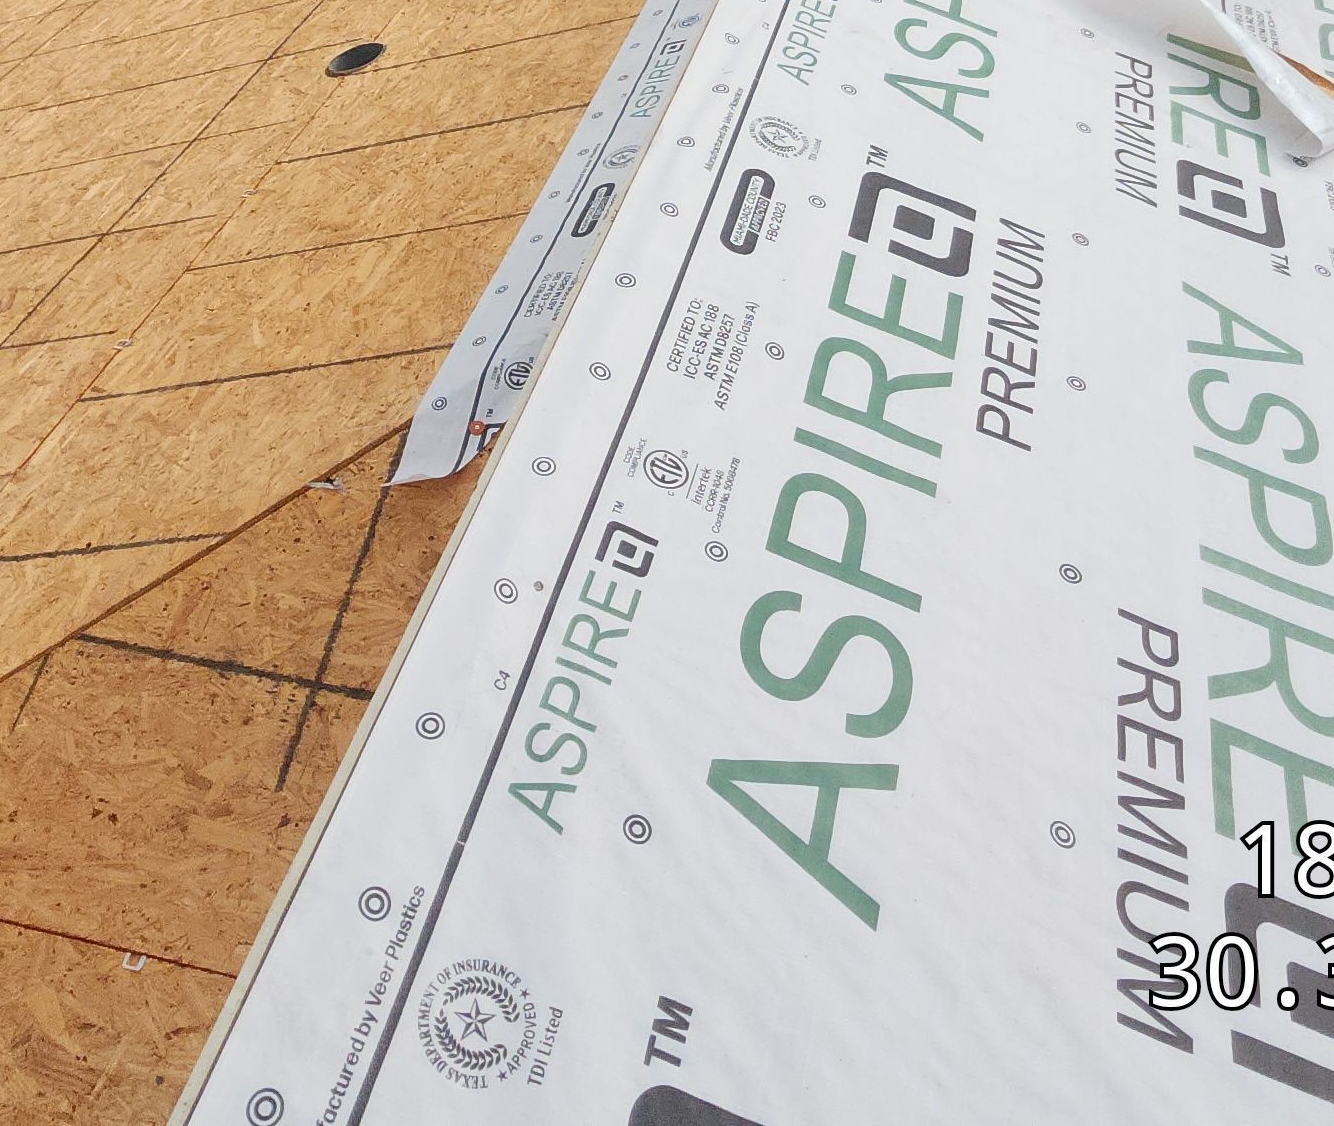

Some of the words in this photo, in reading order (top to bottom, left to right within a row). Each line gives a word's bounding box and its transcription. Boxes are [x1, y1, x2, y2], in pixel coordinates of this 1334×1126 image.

[630, 55, 680, 118] ASPIRE
[1115, 51, 1157, 208] PREMIUM
[765, 223, 780, 242] FBC
[773, 202, 786, 223] 2023
[1271, 253, 1291, 277] TM
[667, 319, 696, 372] CERTIFIED
[689, 297, 704, 318] TO:
[739, 314, 756, 349] (Class
[745, 300, 761, 317] A)
[977, 219, 1045, 451] PREMIUM
[682, 338, 707, 379] ICC-ES
[699, 320, 711, 340] AC
[705, 303, 720, 321] 188
[703, 351, 723, 381] ASTM
[716, 313, 736, 354] D8257
[724, 345, 746, 375] E108
[714, 374, 734, 411] ASTM
[692, 466, 713, 505] Intertek
[706, 250, 963, 931] ASPIRE
[865, 144, 889, 168] TM
[494, 669, 511, 692] C4
[508, 569, 642, 835] ASPIRE
[611, 500, 625, 514] TM
[1117, 609, 1194, 1054] PREMIUM
[384, 885, 426, 961] Plastics
[365, 960, 396, 1007] Veer
[436, 966, 455, 985] OF
[452, 959, 523, 989] INSURANCE
[354, 1010, 378, 1037] by
[417, 984, 449, 1073] DEPARTMENT
[507, 1002, 537, 1075] APPROVED
[527, 1059, 548, 1086] TDI
[539, 1006, 564, 1056] Listed
[643, 995, 694, 1068] TM
[445, 1067, 489, 1089] TEXAS
